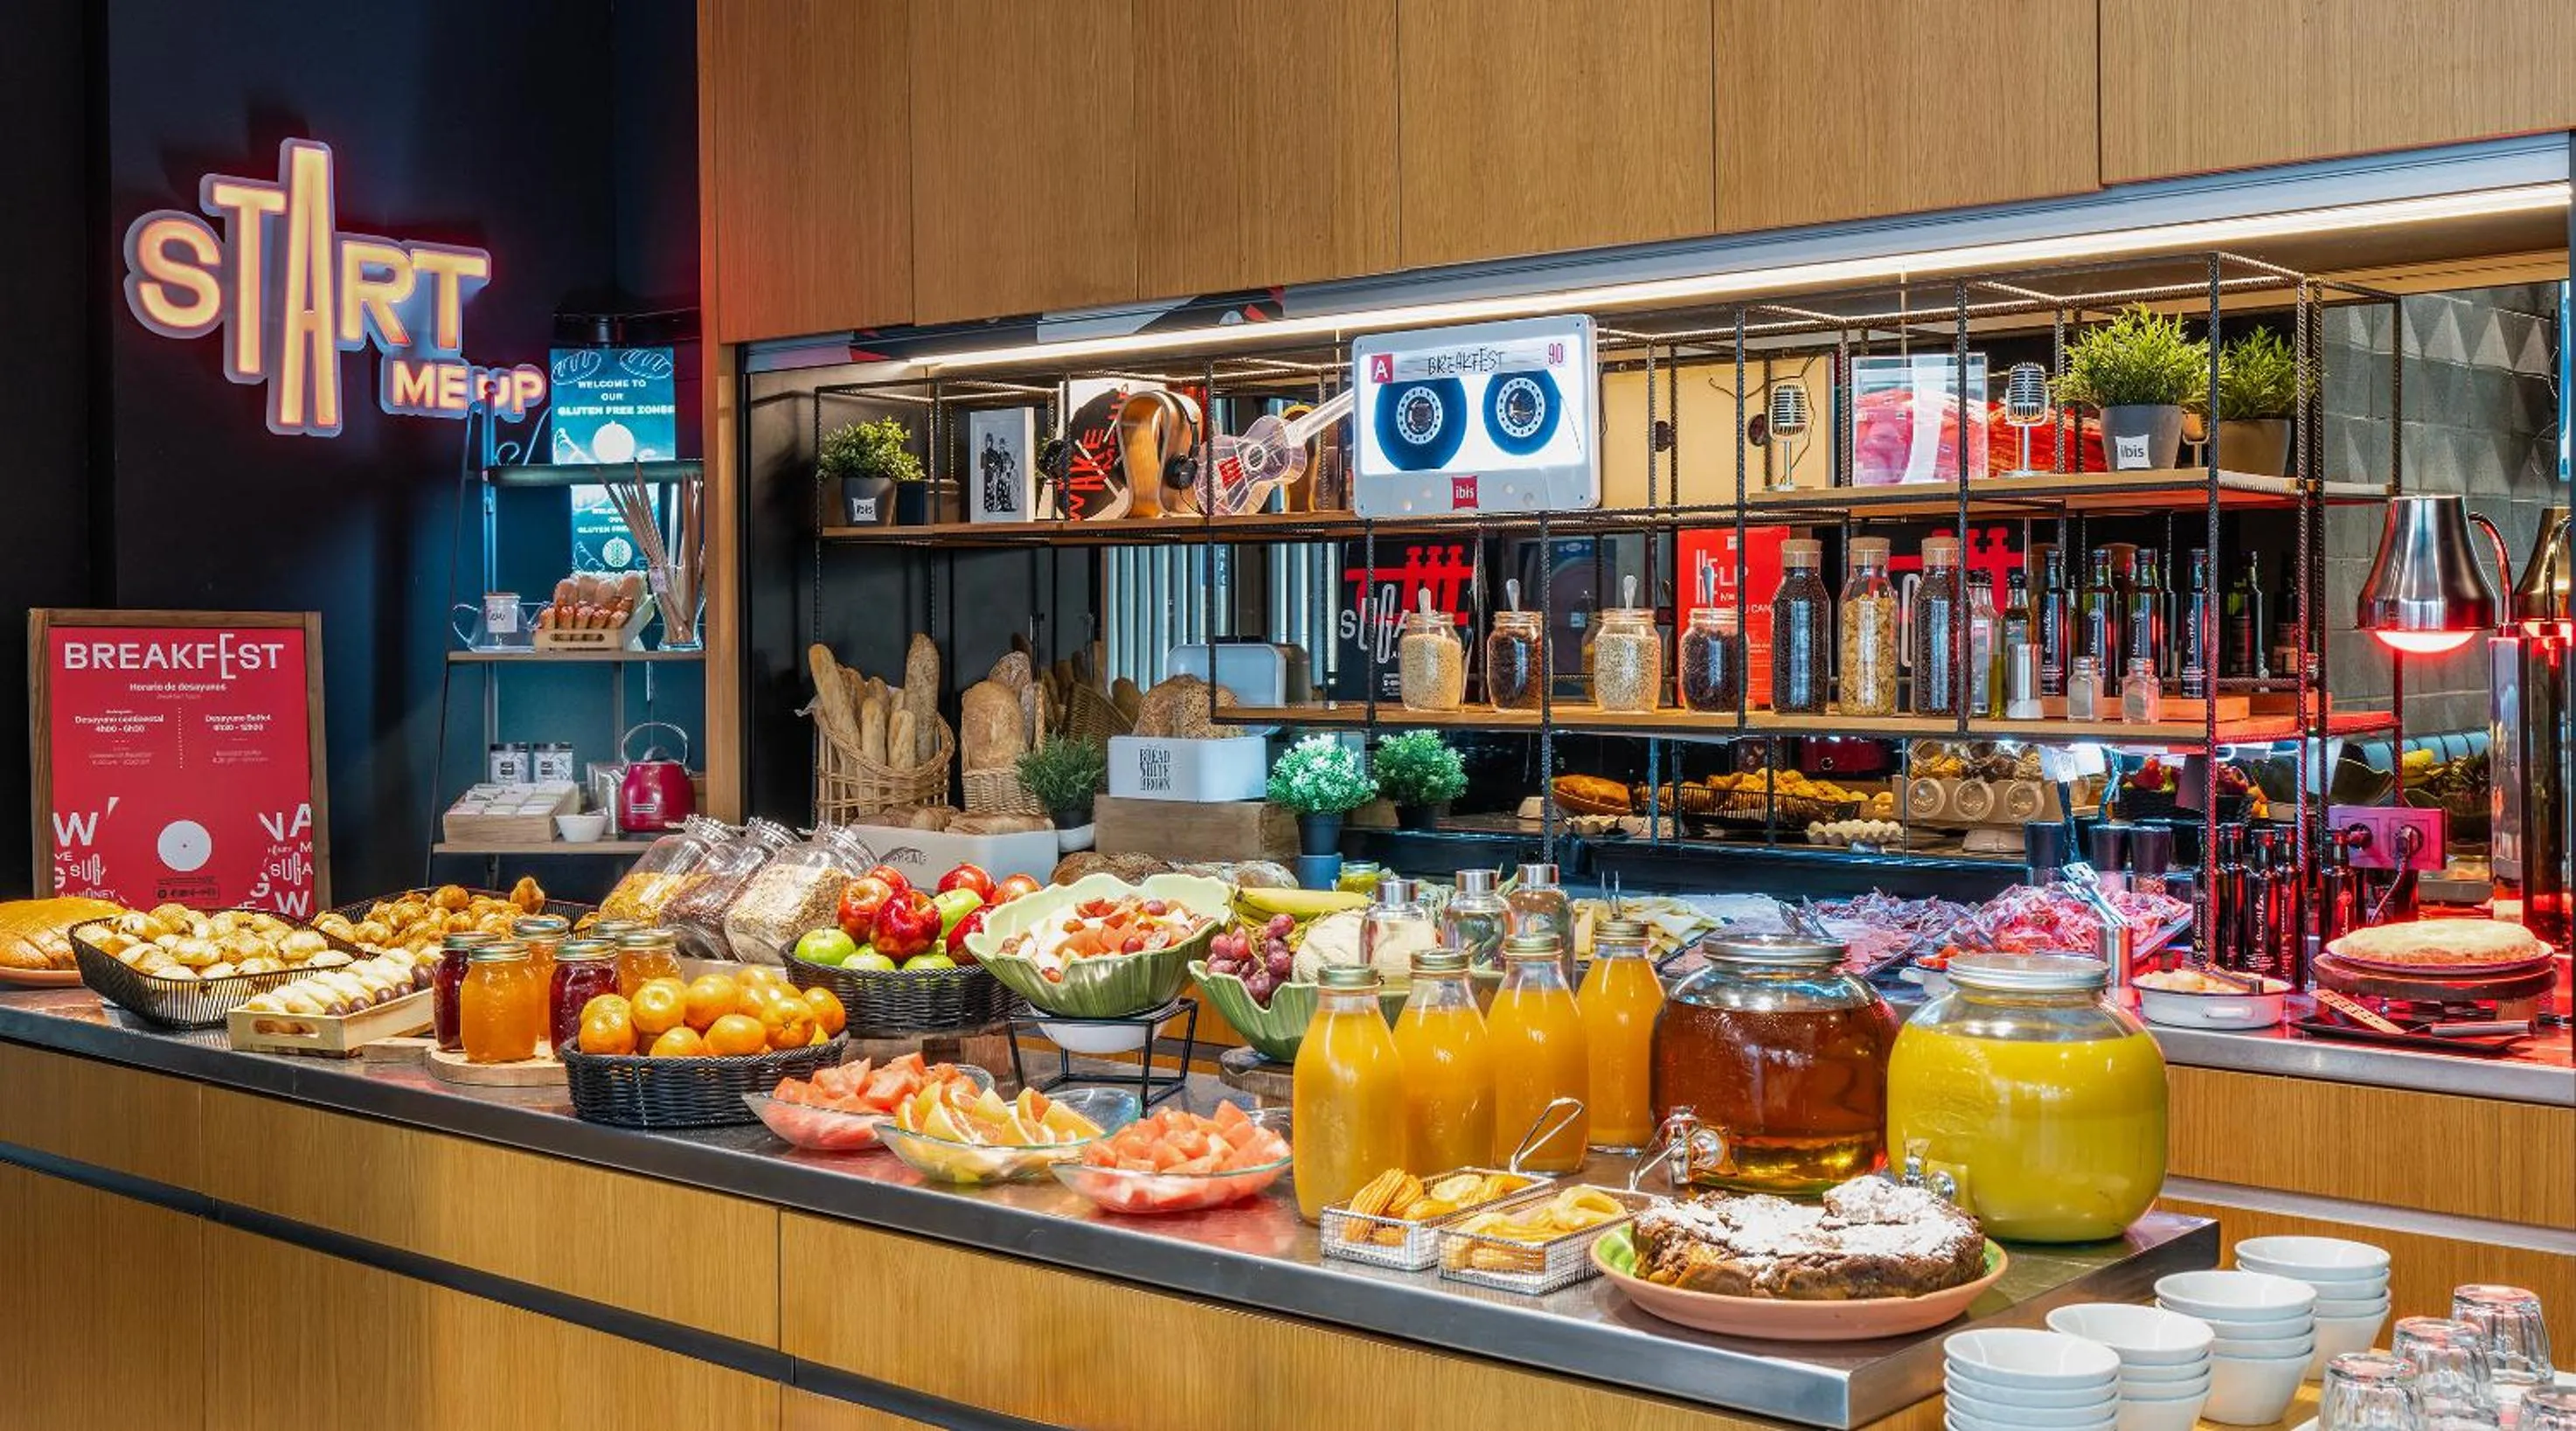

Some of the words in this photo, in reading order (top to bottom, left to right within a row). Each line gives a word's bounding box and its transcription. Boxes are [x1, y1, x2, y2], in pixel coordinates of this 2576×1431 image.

[136, 145, 488, 427] START
[1427, 347, 1505, 376] BREAKFEST
[1547, 343, 1564, 365] 90
[1373, 359, 1389, 380] A
[392, 360, 469, 409] ME
[476, 371, 544, 413] UP
[577, 379, 629, 389] WELCOME
[632, 378, 647, 388] TO
[601, 392, 624, 401] OUR
[557, 406, 603, 417] GLUTEN
[605, 405, 635, 415] FREE
[1455, 484, 1475, 499] ibis
[64, 633, 284, 680] BREAKFEST
[164, 682, 176, 691] de
